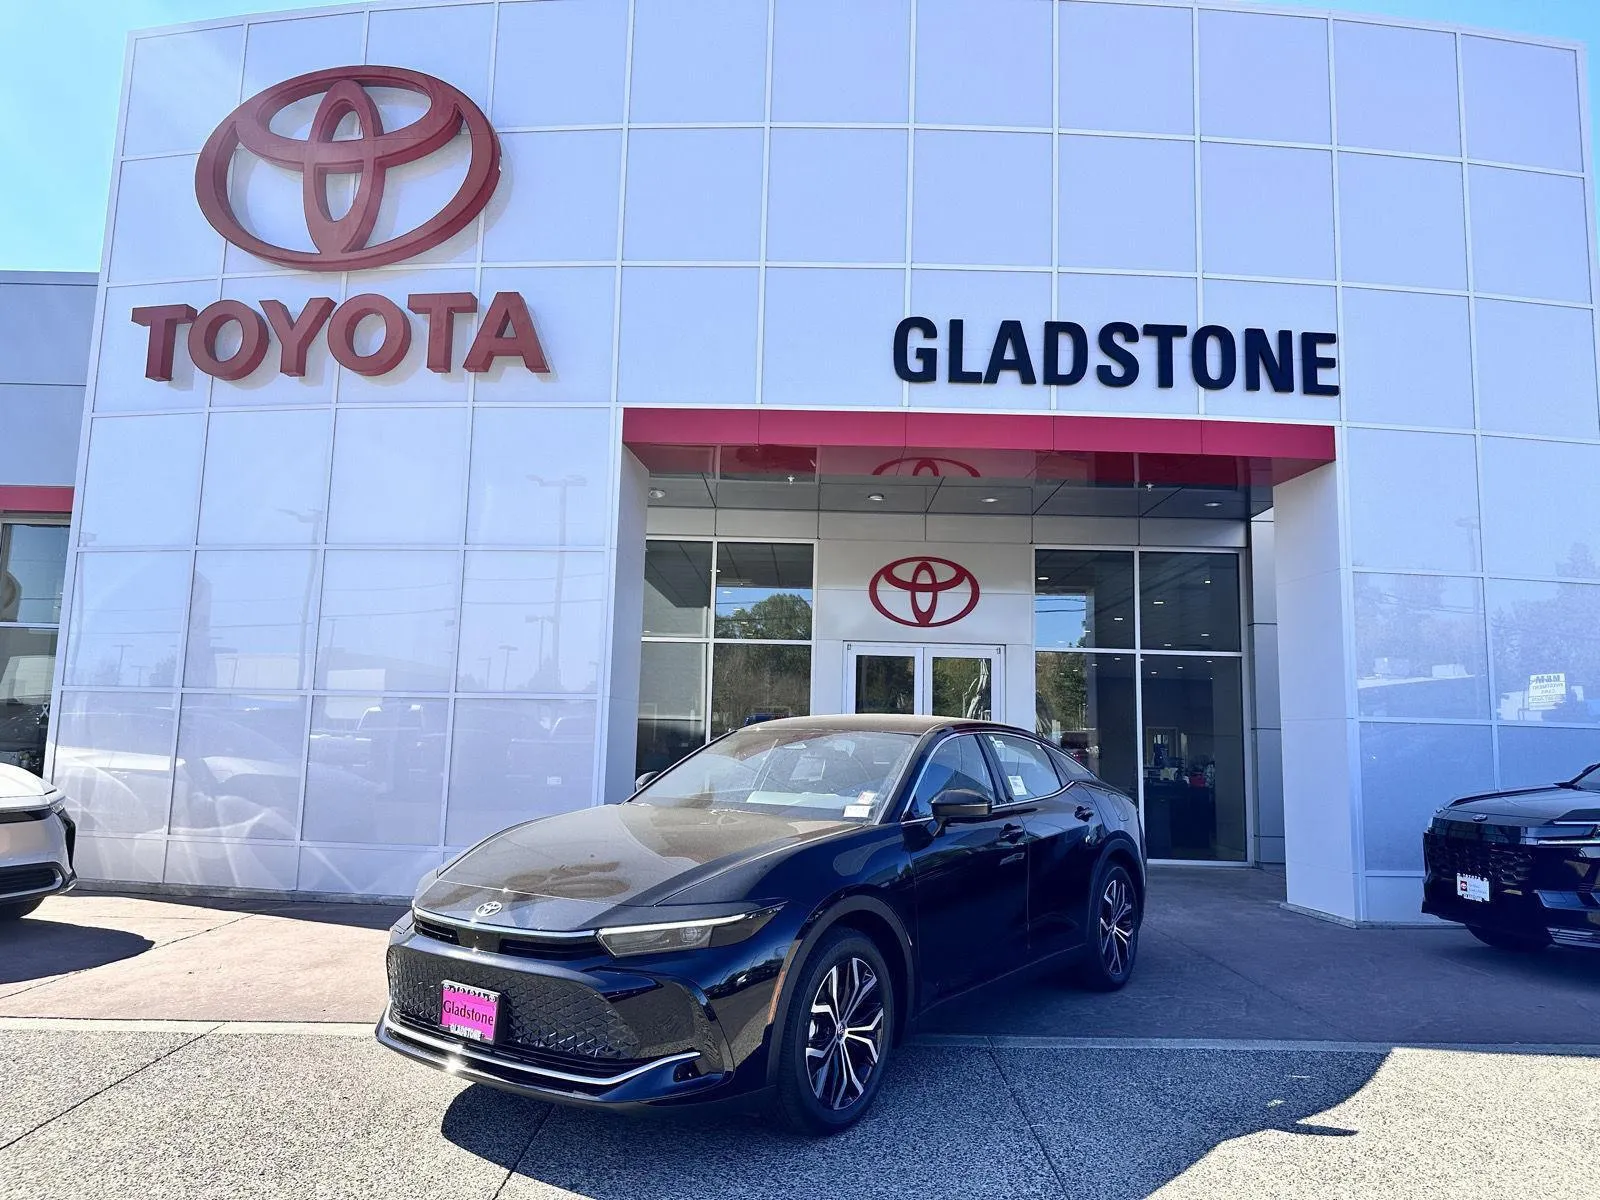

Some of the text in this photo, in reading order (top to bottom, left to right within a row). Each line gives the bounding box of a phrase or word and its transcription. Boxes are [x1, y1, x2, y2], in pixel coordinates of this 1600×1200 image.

[131, 292, 550, 381] TOYOTA
[893, 316, 1339, 396] GLADSTONE
[443, 1000, 494, 1026] Gladstone
